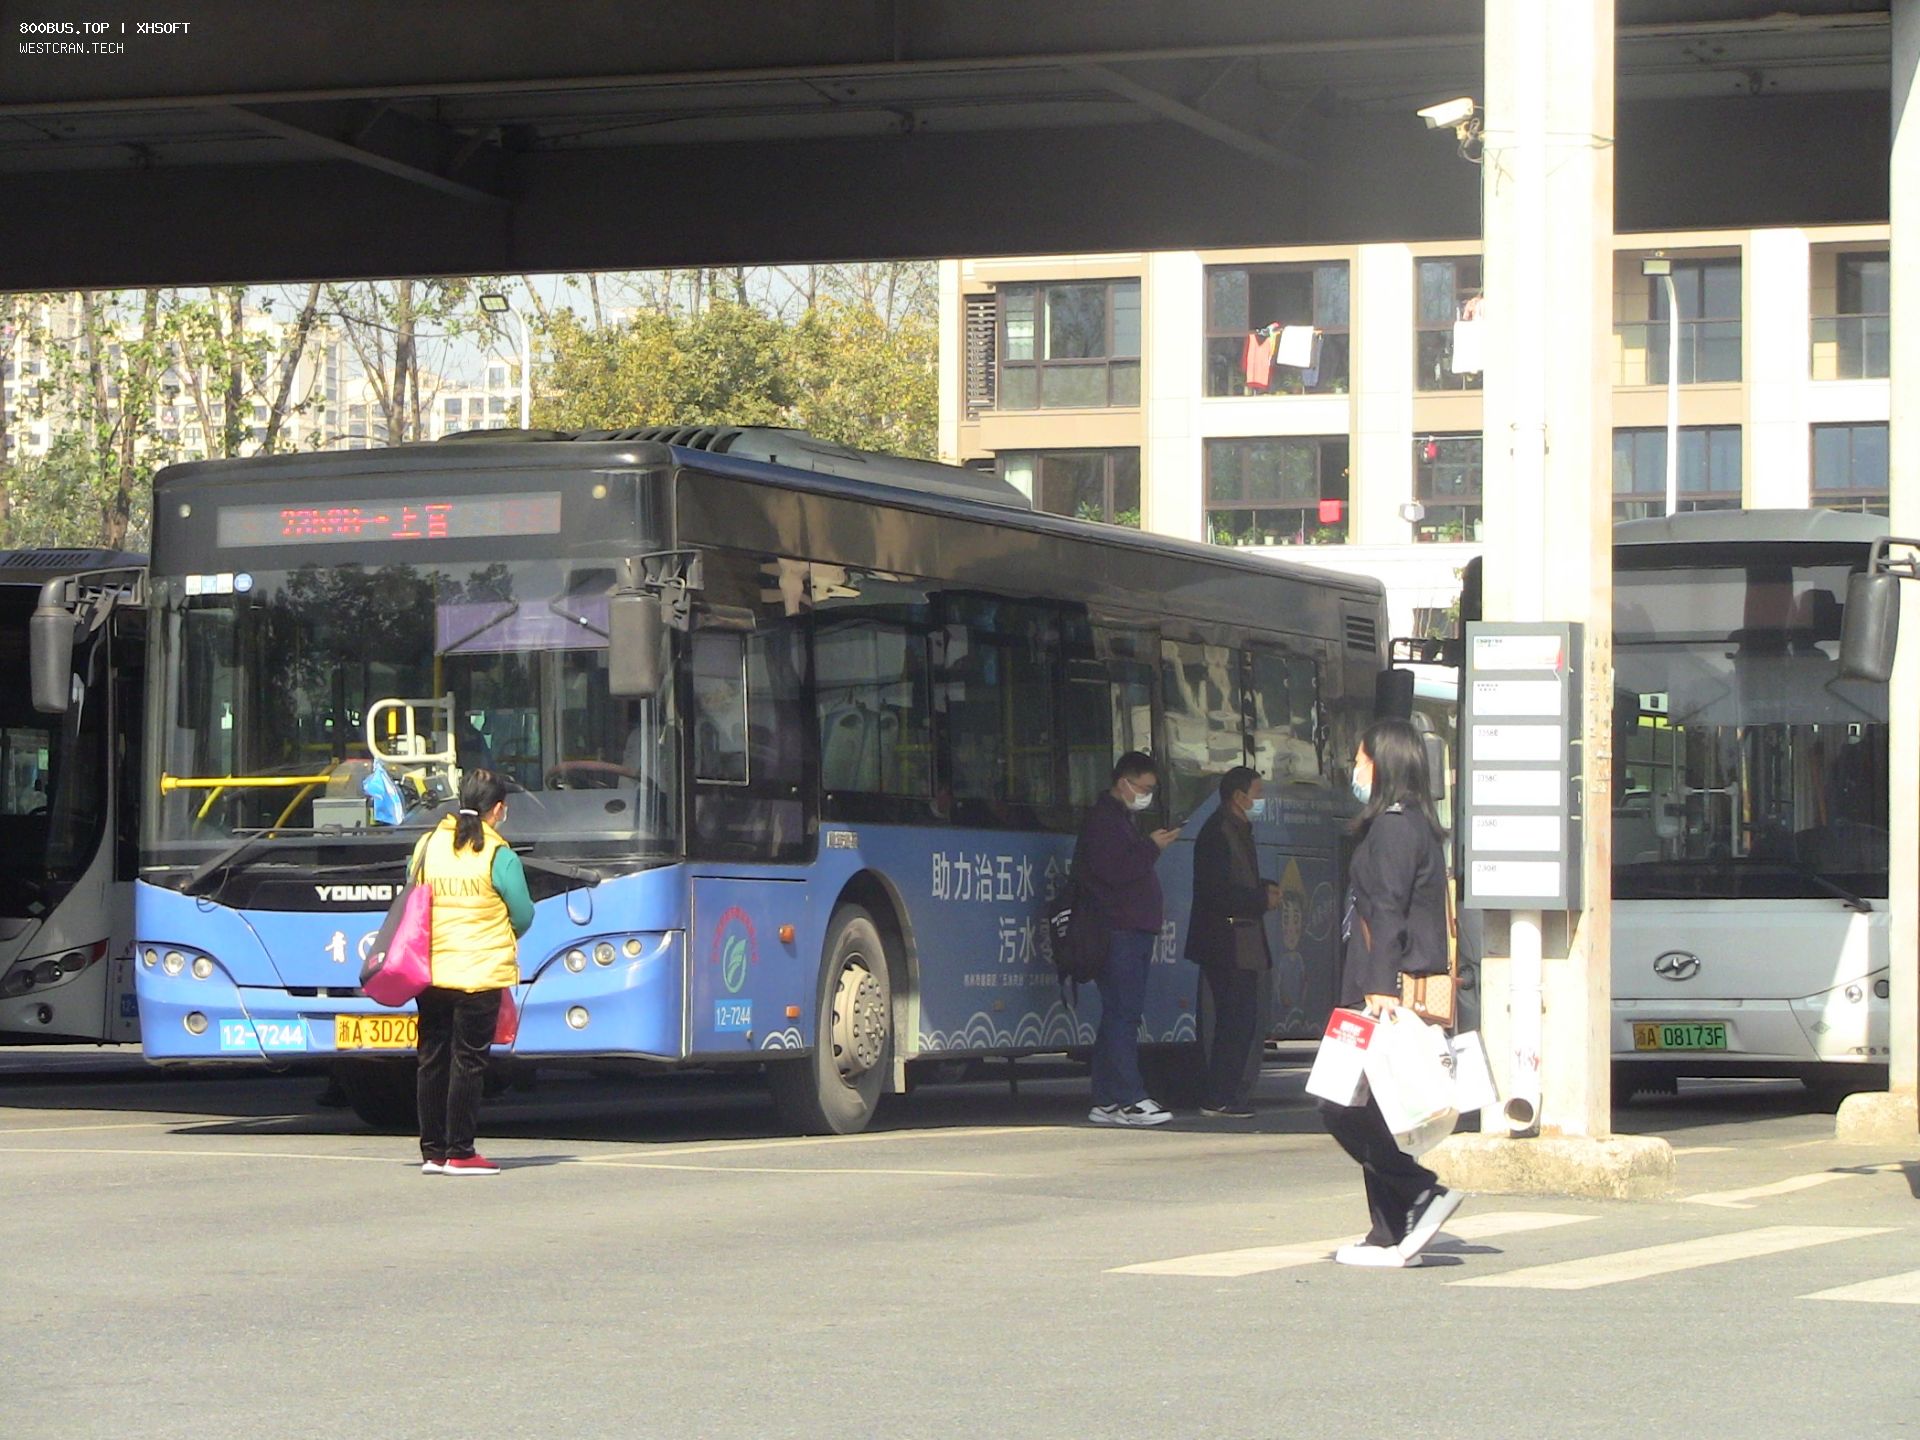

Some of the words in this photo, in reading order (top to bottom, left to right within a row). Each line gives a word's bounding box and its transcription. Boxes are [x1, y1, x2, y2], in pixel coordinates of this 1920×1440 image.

[931, 851, 1035, 903] 助力治五水
[716, 1006, 751, 1026] 12-7244
[222, 1024, 304, 1046] 12-7244
[1663, 1026, 1723, 1046] 08173F
